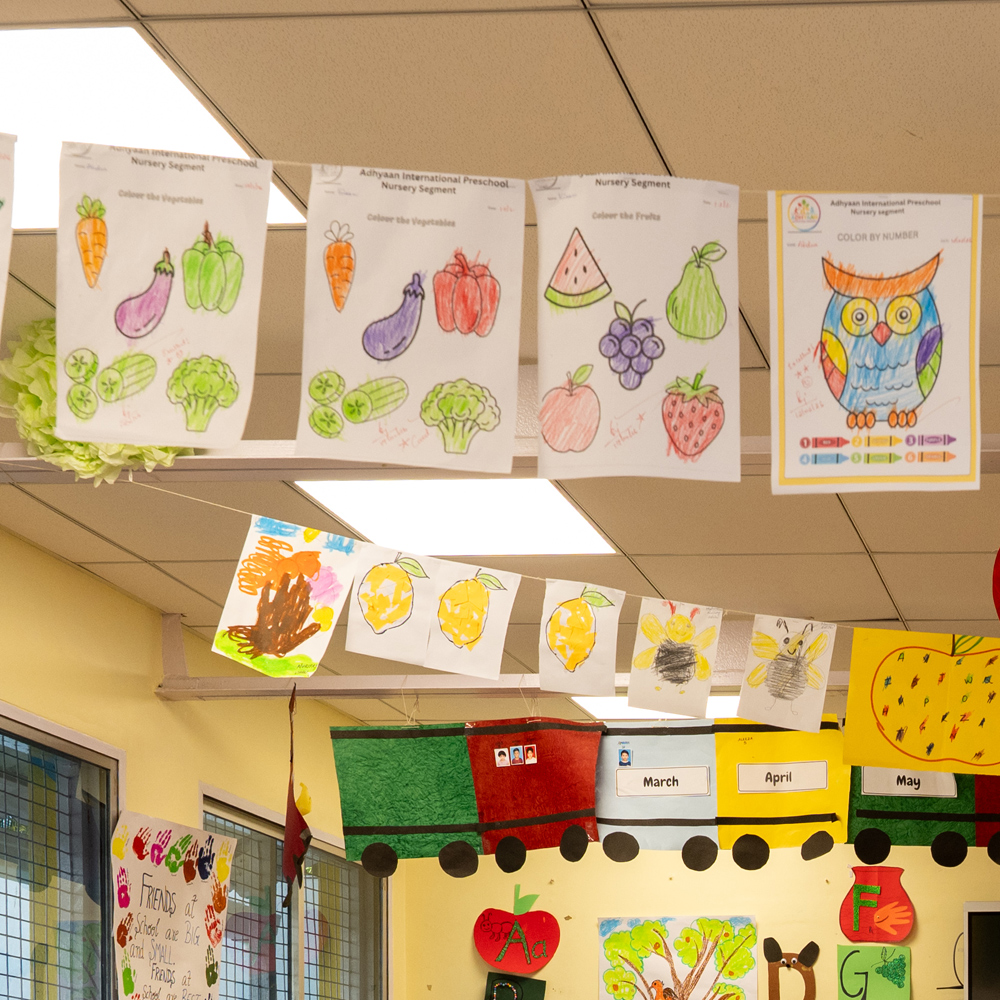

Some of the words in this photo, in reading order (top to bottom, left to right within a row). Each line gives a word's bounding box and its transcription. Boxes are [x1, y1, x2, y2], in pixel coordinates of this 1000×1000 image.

[131, 156, 166, 170] Nursery
[169, 160, 205, 172] Segment
[212, 155, 259, 168] Preschool
[359, 168, 400, 180] Adhyaan
[402, 172, 461, 184] International
[463, 175, 509, 188] Preschool
[595, 178, 629, 188] Nursery
[631, 178, 671, 189] Segment
[381, 181, 417, 193] Nursery
[419, 184, 456, 195] Segment
[118, 189, 145, 200] Colour
[147, 191, 160, 201] the
[161, 193, 203, 205] Vegetables
[830, 199, 860, 208] Adhyaan
[861, 199, 906, 207] International
[592, 211, 618, 220] Colour
[620, 211, 634, 220] the
[635, 212, 661, 221] Fruits
[850, 208, 877, 216] Nursery
[878, 208, 905, 216] segment
[367, 213, 394, 223] Colour
[396, 215, 410, 224] the
[411, 216, 456, 228] Vegetables
[837, 232, 867, 242] COLOR
[869, 232, 881, 241] BY
[882, 231, 919, 241] NUMBER
[643, 776, 679, 787] March
[765, 771, 792, 786] April
[896, 775, 921, 790] May
[140, 873, 176, 918] FRIENDS
[185, 895, 198, 919] at
[852, 884, 881, 931] F
[134, 913, 160, 940] School
[165, 929, 179, 942] are
[184, 921, 200, 946] BIG
[130, 939, 144, 959] and
[181, 970, 191, 986] at
